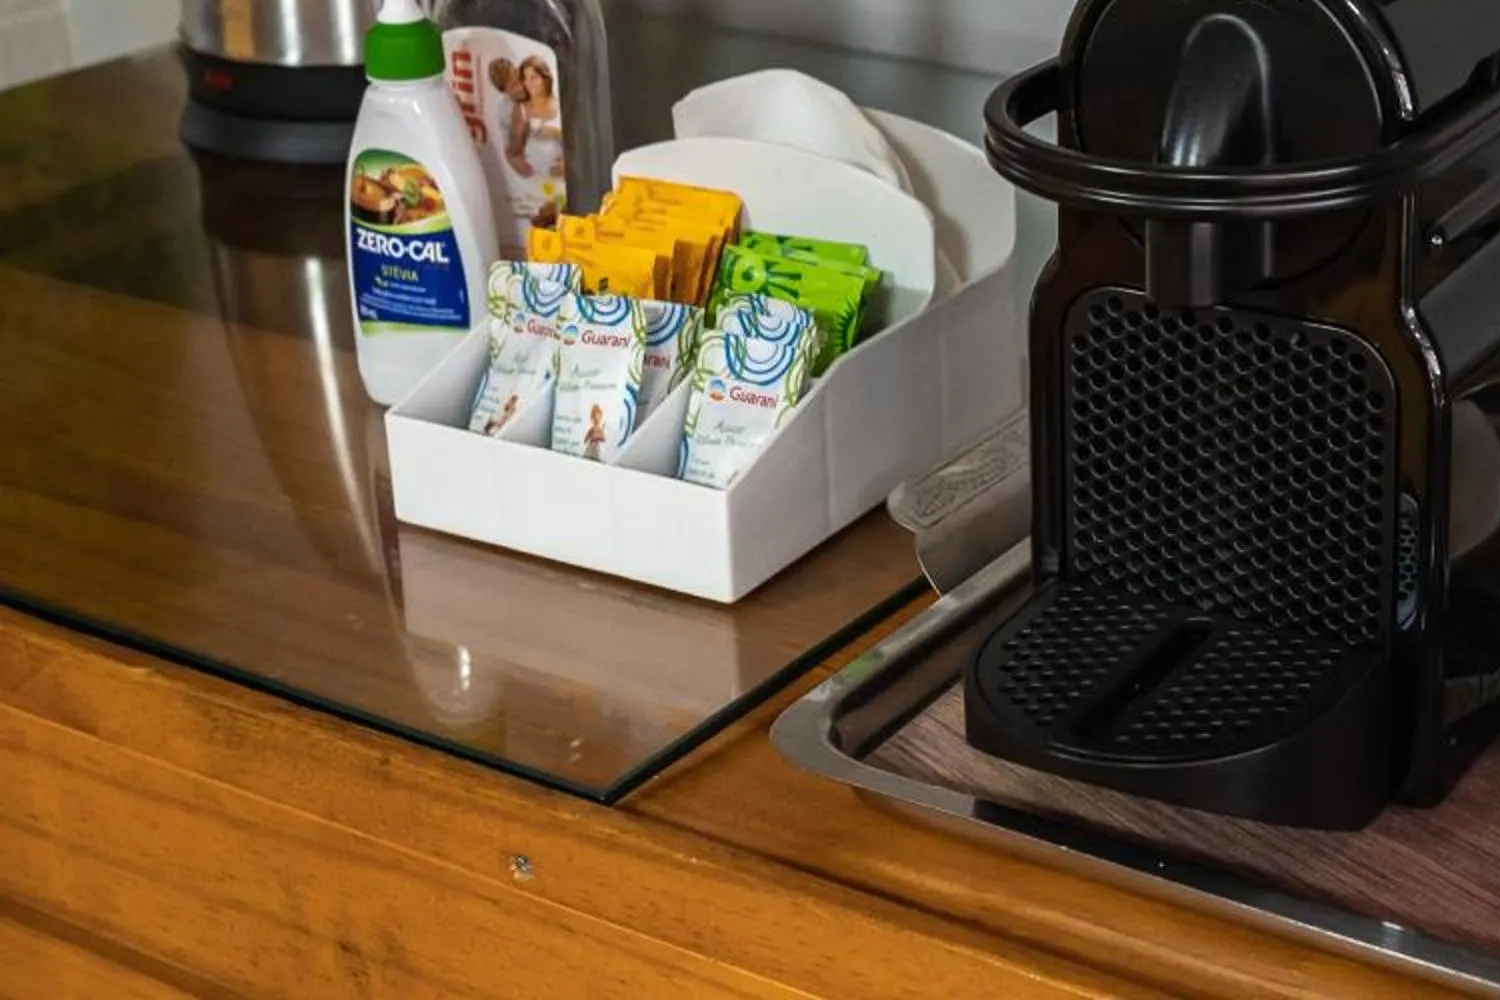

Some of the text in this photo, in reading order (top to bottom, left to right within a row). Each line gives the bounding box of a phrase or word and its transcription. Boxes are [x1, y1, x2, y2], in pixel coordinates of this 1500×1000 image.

[581, 329, 633, 348] Guarani
[644, 351, 671, 370] rani
[729, 385, 779, 409] Guarani
